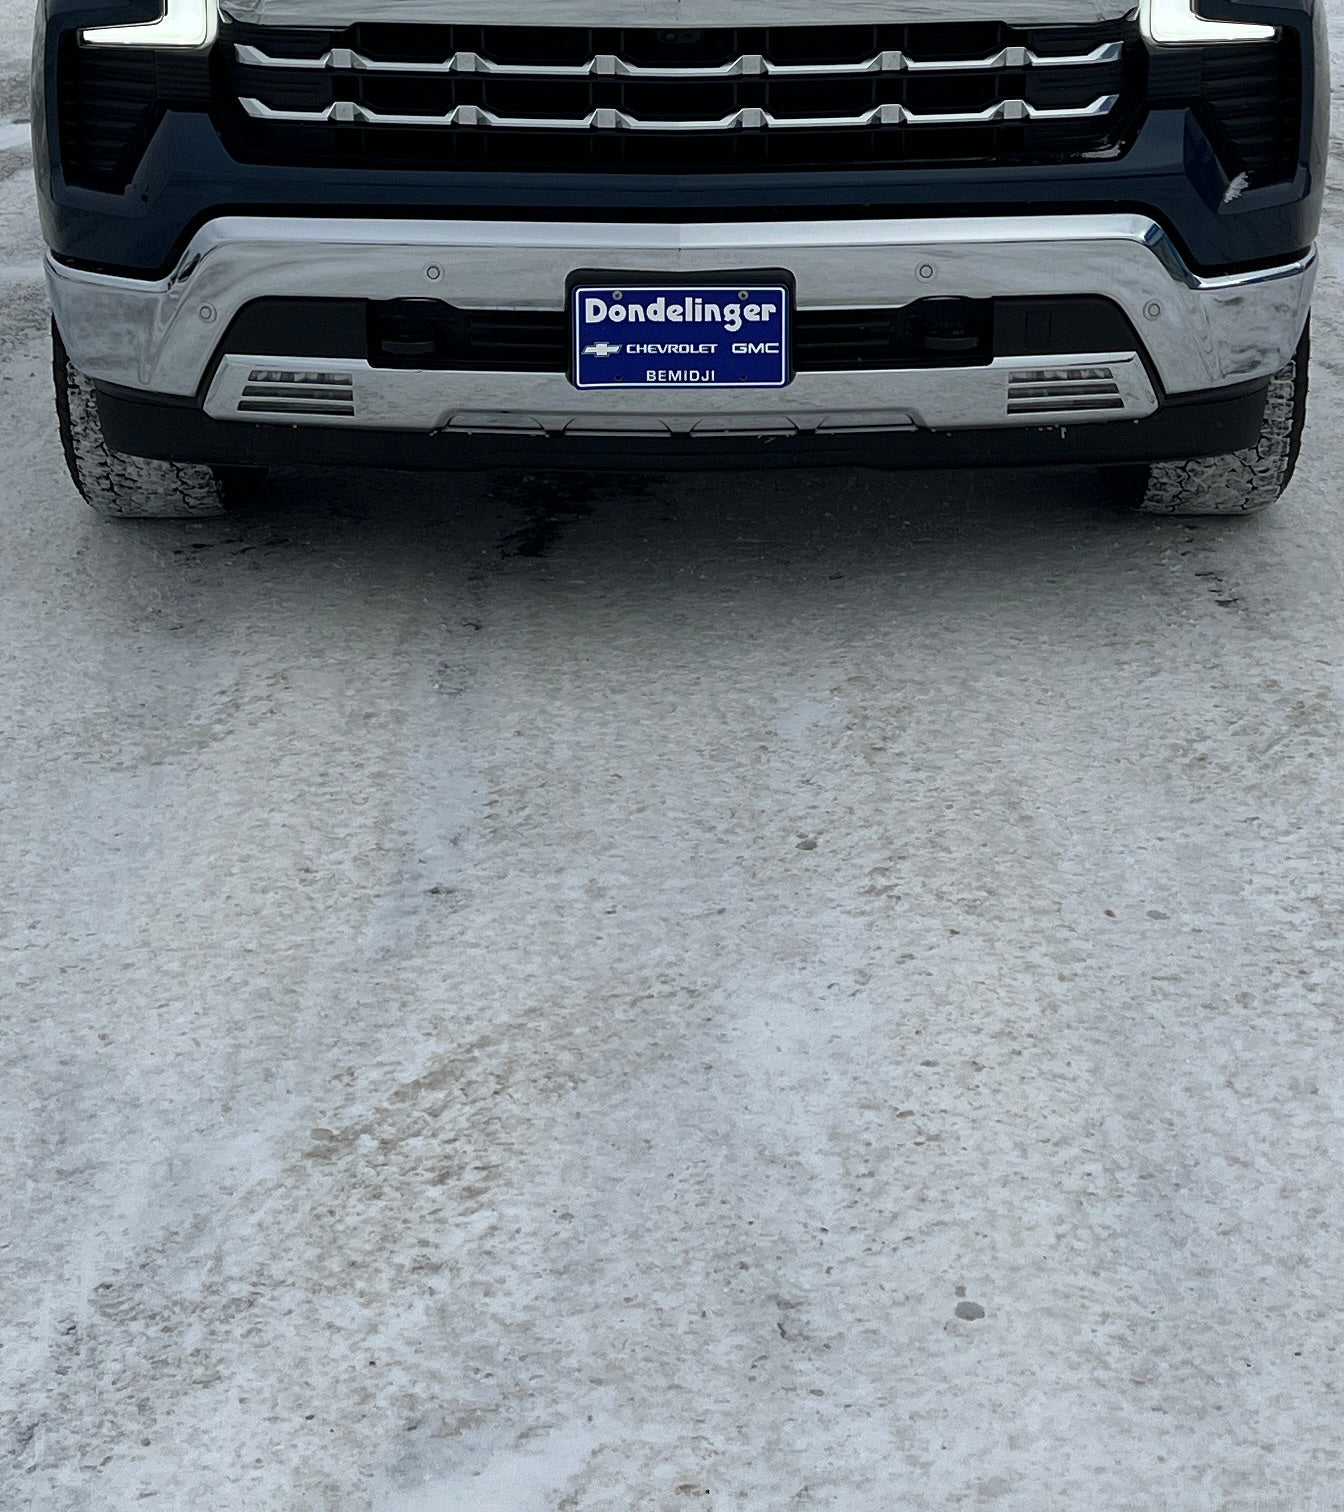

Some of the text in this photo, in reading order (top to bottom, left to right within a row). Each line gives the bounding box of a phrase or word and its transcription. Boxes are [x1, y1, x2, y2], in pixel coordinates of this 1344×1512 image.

[585, 297, 777, 332] Dondelinger
[626, 343, 780, 354] CHEVROLET GMC
[646, 370, 715, 382] BEMIDJI
